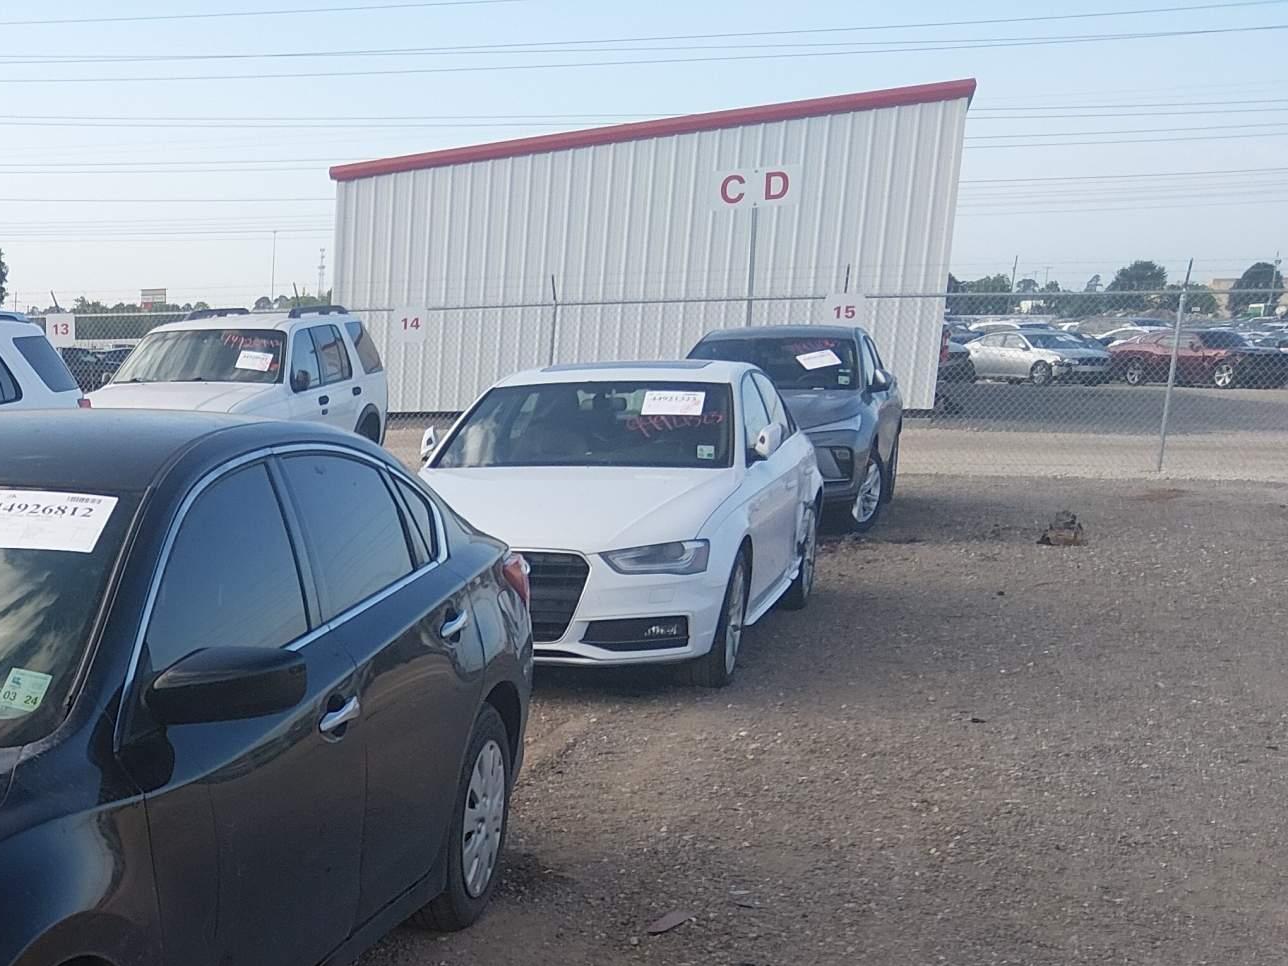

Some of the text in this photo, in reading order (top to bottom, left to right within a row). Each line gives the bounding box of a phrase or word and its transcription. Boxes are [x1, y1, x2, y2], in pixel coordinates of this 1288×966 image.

[720, 171, 789, 204] C D
[833, 305, 856, 319] 15
[53, 323, 69, 335] 13
[401, 317, 420, 330] 14
[2, 690, 17, 701] 03
[23, 695, 39, 705] 24
